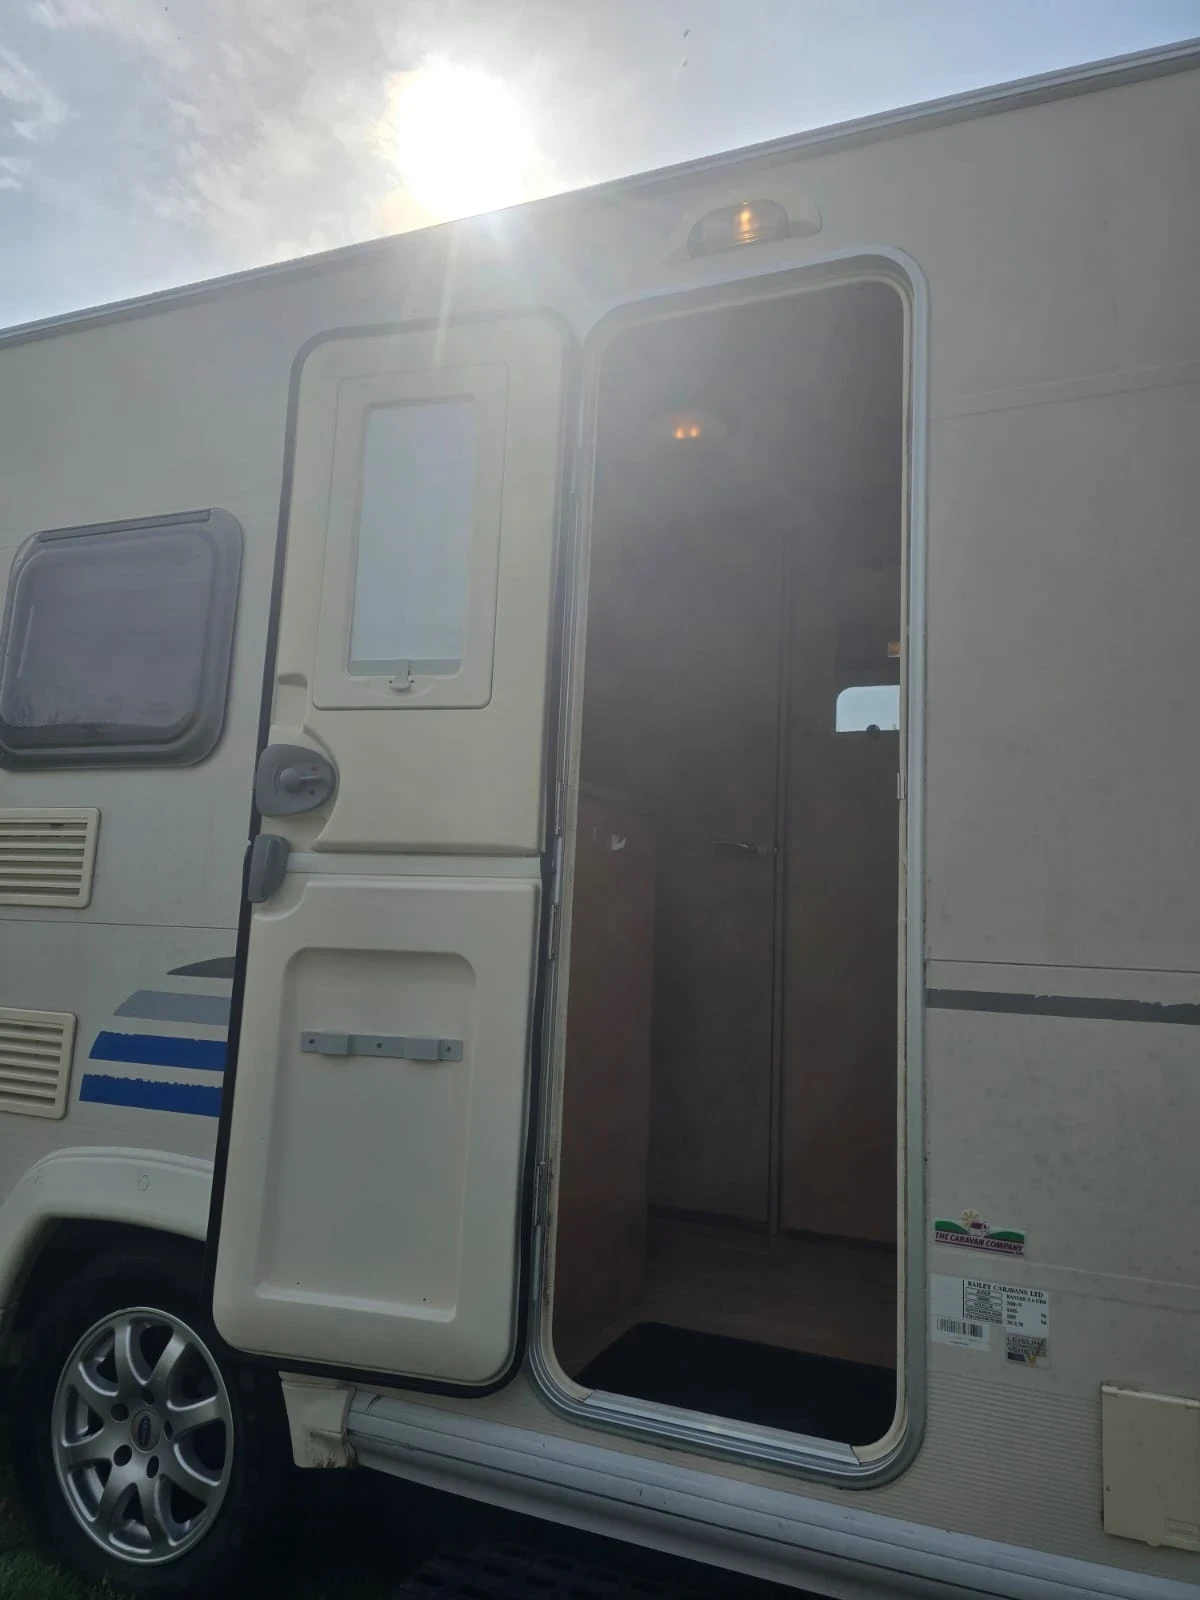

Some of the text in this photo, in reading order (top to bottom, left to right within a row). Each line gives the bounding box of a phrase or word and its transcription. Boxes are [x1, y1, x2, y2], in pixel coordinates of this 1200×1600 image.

[935, 1231, 1024, 1251] THE CARAVAN COMPANY
[993, 1284, 1028, 1296] CARAVANS
[1030, 1289, 1044, 1299] LTD
